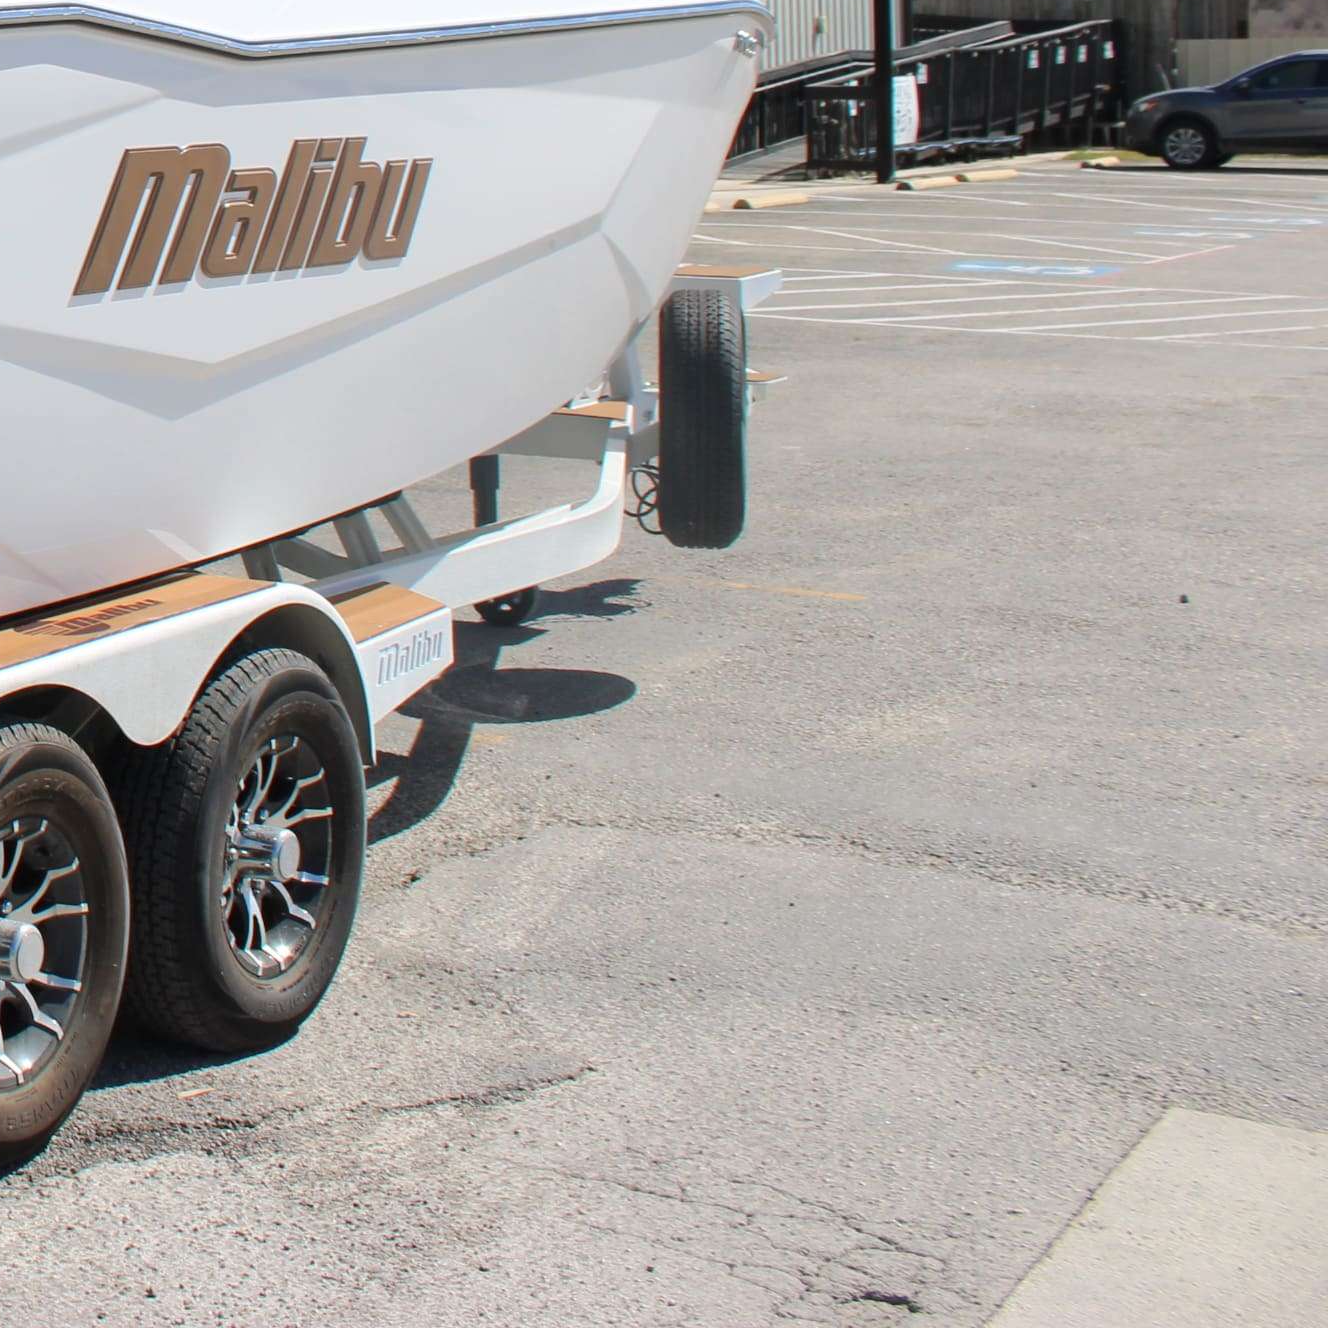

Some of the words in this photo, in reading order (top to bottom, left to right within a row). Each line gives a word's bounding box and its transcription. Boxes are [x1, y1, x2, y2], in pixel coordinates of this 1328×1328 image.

[71, 135, 435, 297] Malibu
[52, 598, 165, 630] Malibu
[376, 629, 443, 686] Malibu
